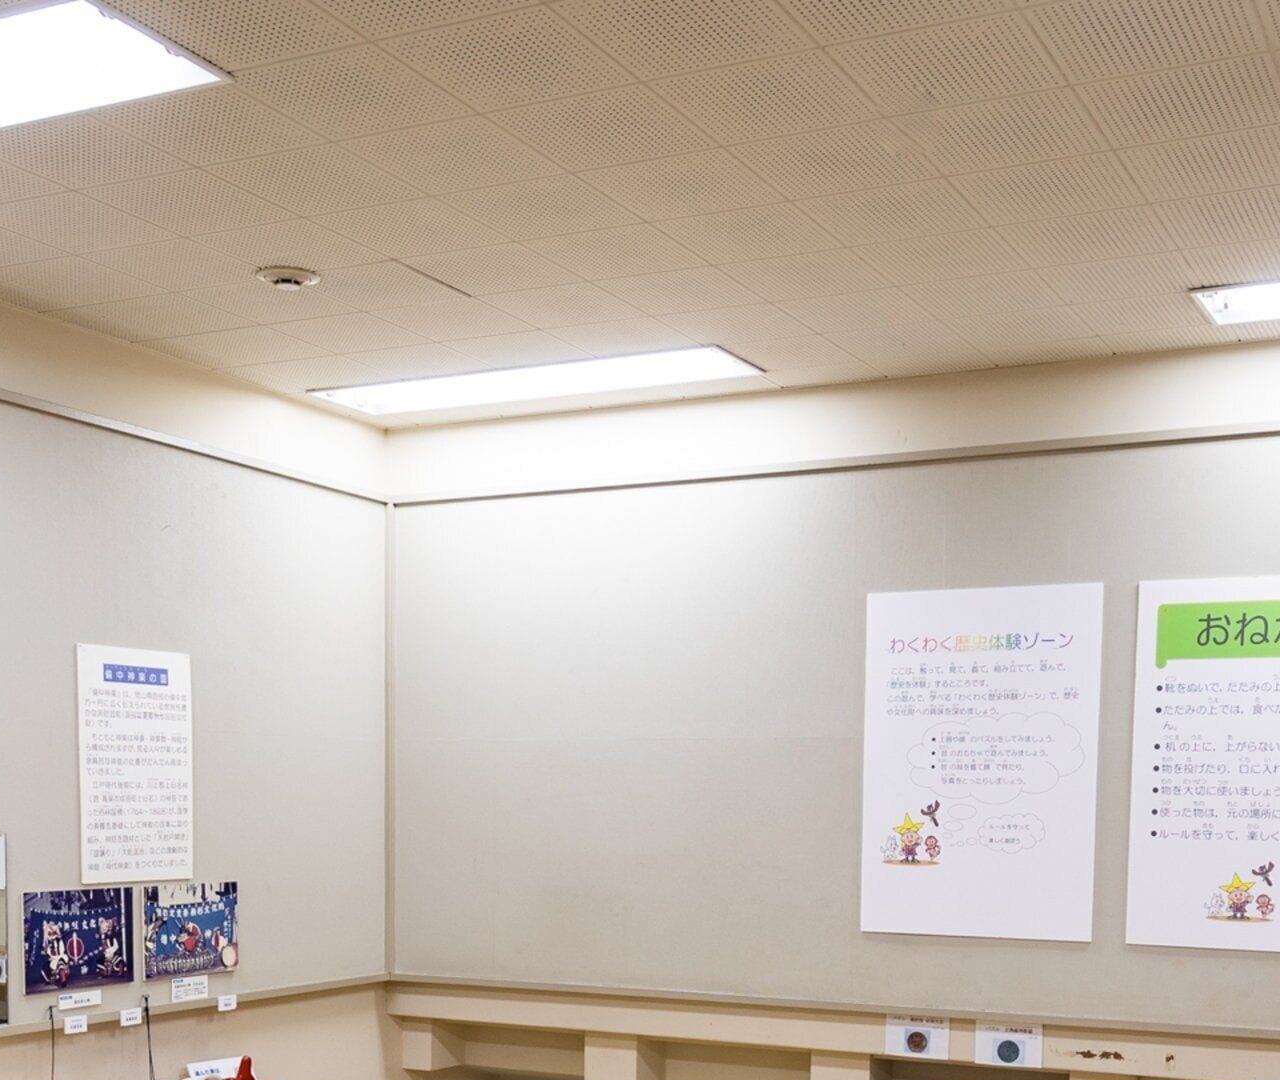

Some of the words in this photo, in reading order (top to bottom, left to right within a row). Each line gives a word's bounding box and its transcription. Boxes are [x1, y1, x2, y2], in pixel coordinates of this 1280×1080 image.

[889, 632, 1074, 654] わくわく歴史体験ゾーン
